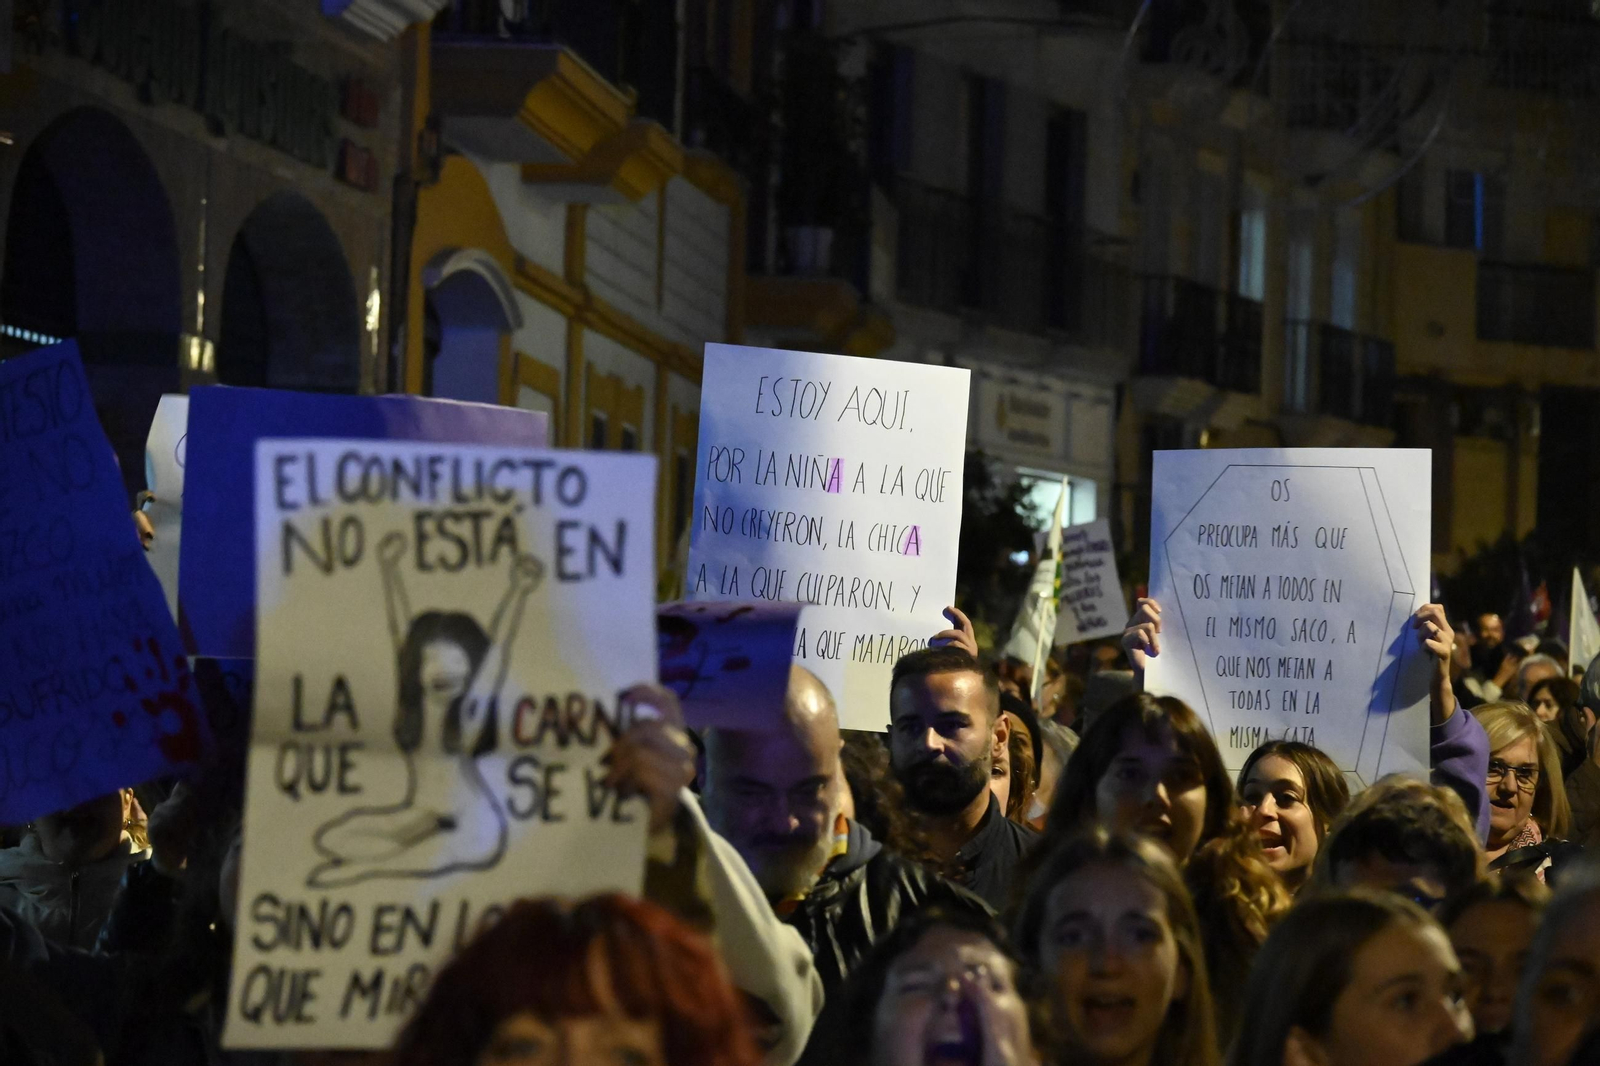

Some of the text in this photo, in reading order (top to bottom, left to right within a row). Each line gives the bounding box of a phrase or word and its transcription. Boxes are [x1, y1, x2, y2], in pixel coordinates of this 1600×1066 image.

[755, 376, 832, 421] ESTOY
[336, 450, 588, 508] CONFLICTO
[706, 445, 952, 503] POR LA NIÑA A LA QUE
[1270, 478, 1291, 502] OS
[281, 503, 628, 582] NO ESTÁ EN
[703, 505, 921, 556] NO CREYERON, LA CHICA
[1197, 521, 1349, 550] PREOCUPA MÁS QUE
[695, 563, 708, 594] A
[720, 565, 740, 597] LA
[751, 566, 787, 602] QUE
[909, 585, 922, 614] Y
[1193, 573, 1342, 603] OS METAN A TODOS EN
[816, 629, 847, 660] QUE
[1205, 616, 1357, 645] EL MISMO SACO, A
[1216, 655, 1333, 682] QUE NOS METAN A
[292, 673, 632, 748] LA CARN
[1228, 690, 1320, 715] TODAS EN LA
[1229, 725, 1269, 749] MISMA
[275, 740, 365, 803] QUE
[506, 755, 567, 823] SE
[249, 893, 356, 952] SINO
[370, 897, 441, 956] EN
[240, 963, 323, 1026] QUE
